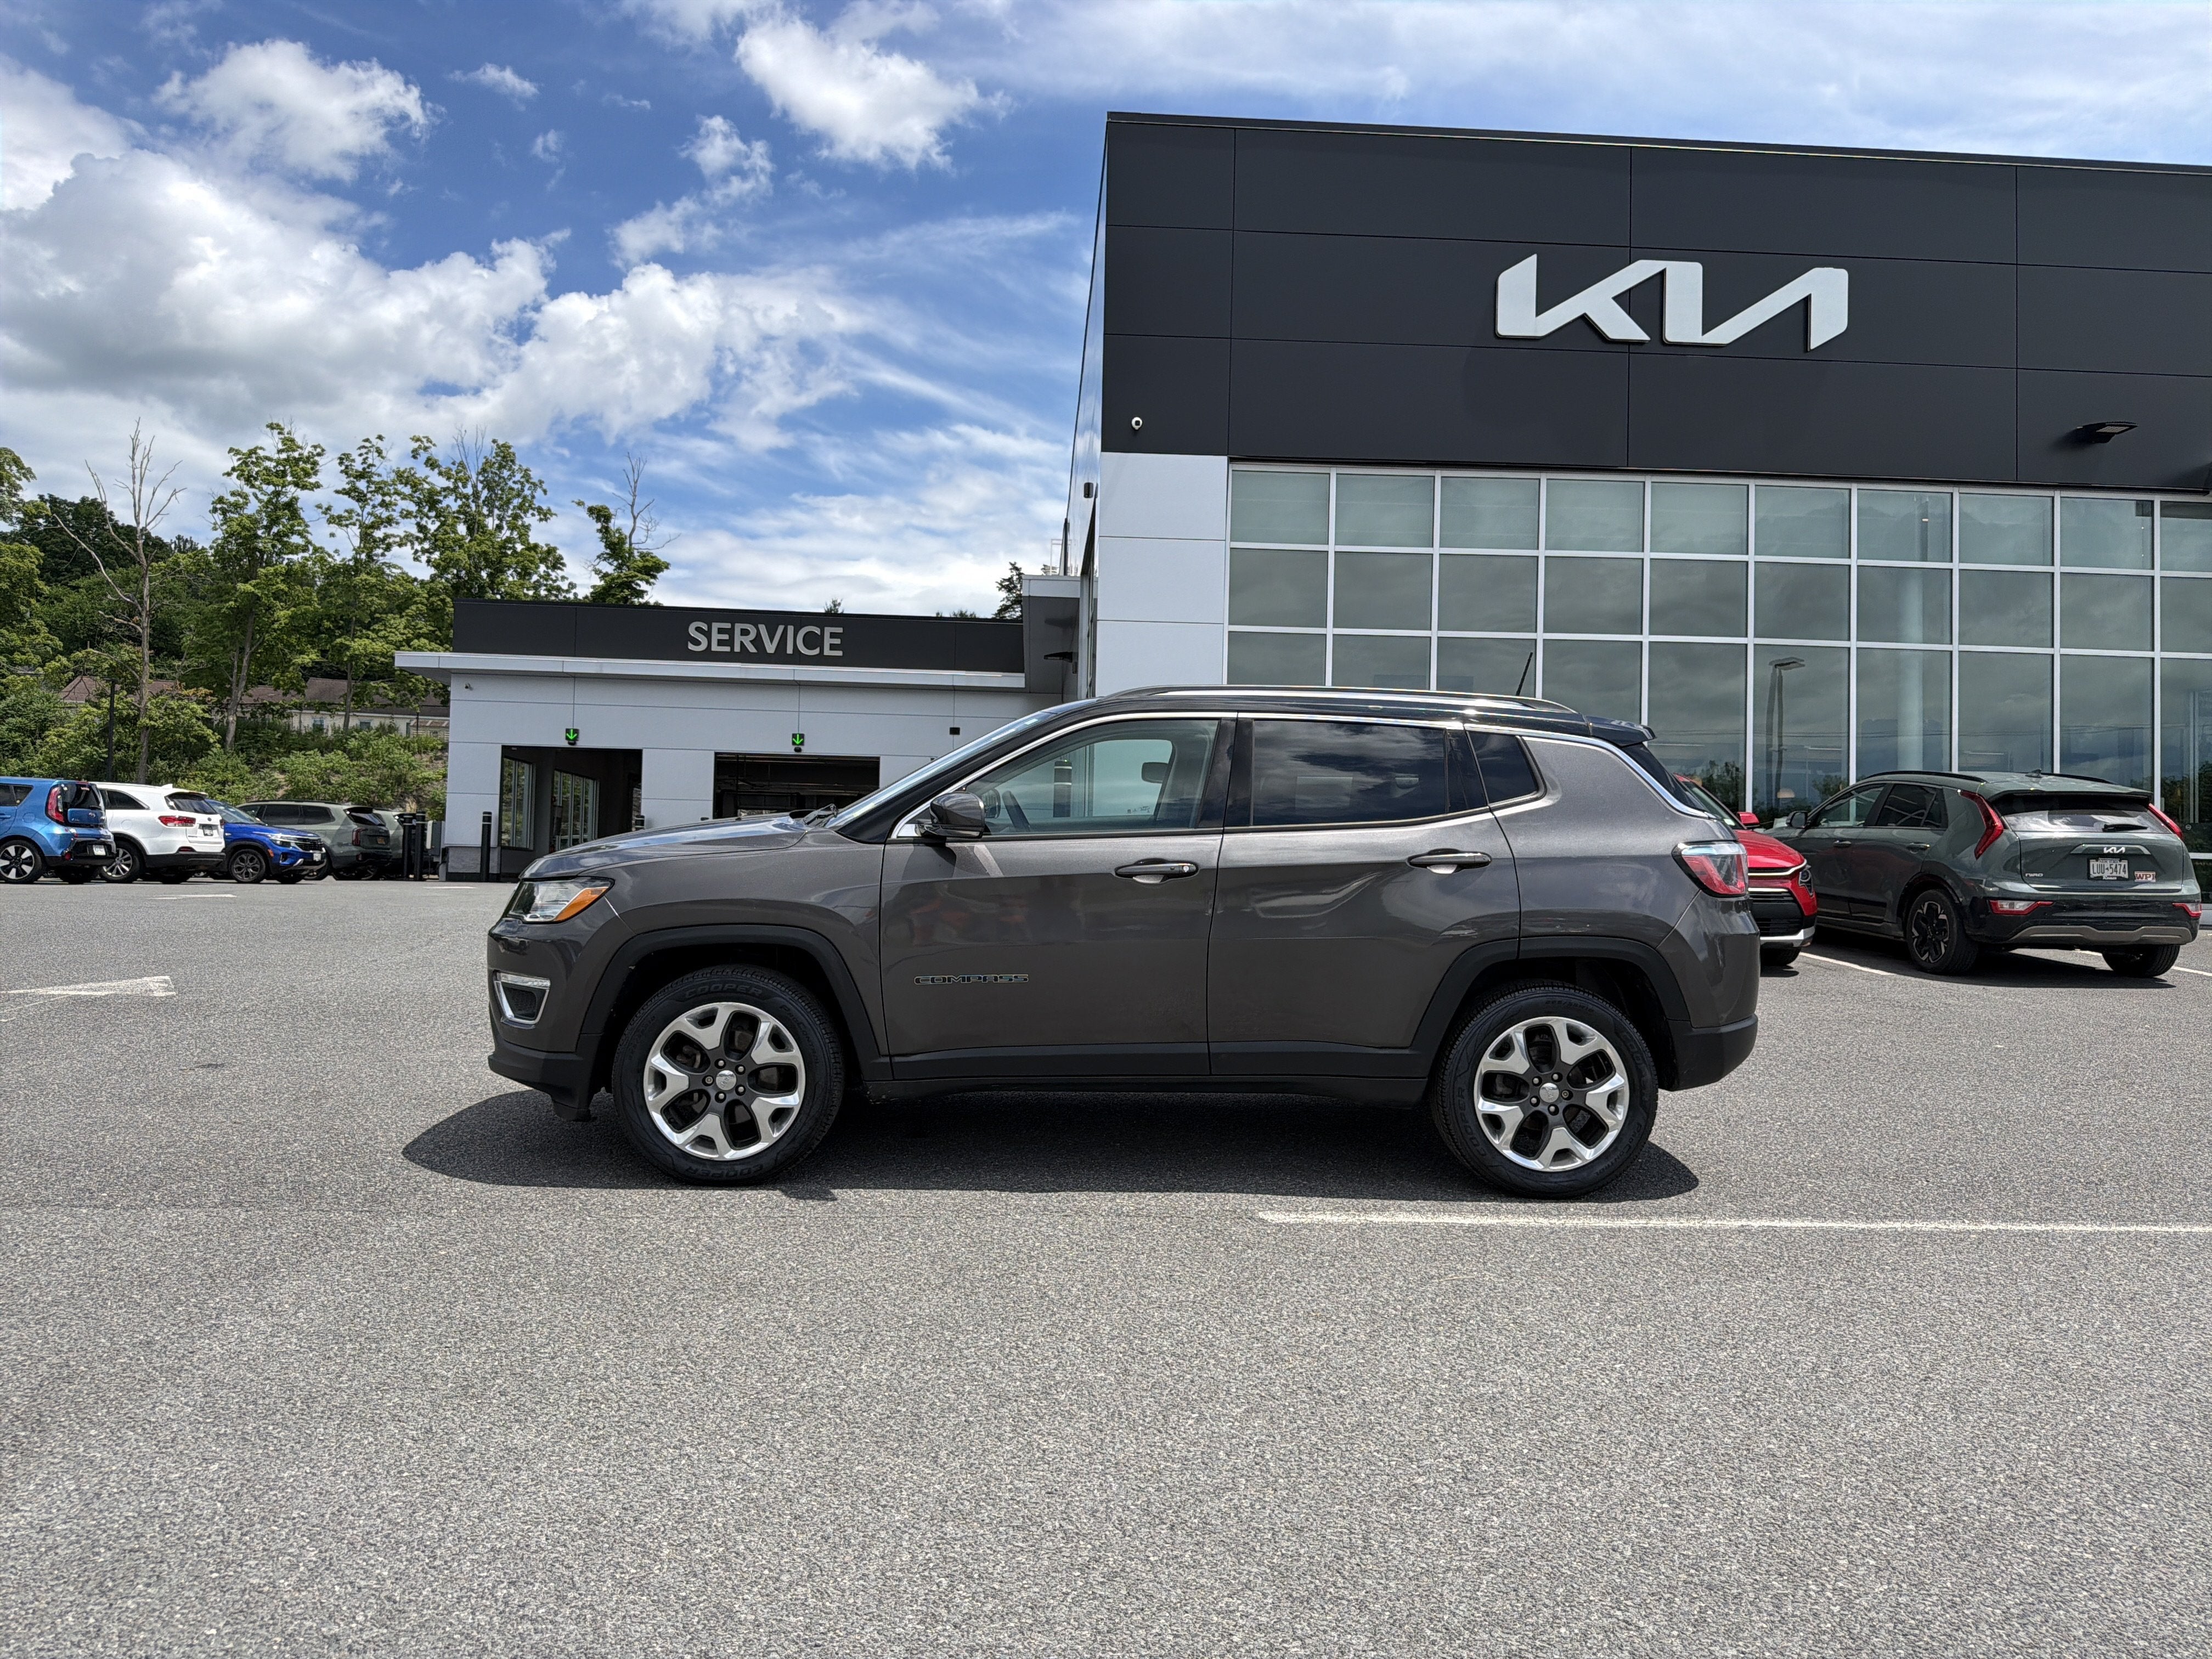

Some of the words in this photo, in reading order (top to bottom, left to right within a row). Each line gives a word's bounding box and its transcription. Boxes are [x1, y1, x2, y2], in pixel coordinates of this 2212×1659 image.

[1496, 254, 1848, 352] KIA
[688, 622, 843, 656] SERVICE
[2109, 864, 2126, 875] 5474
[914, 974, 1029, 985] COMPASS
[684, 983, 763, 998] COOPER
[1459, 1087, 1486, 1157] COOPER
[685, 1163, 765, 1178] COOPER
